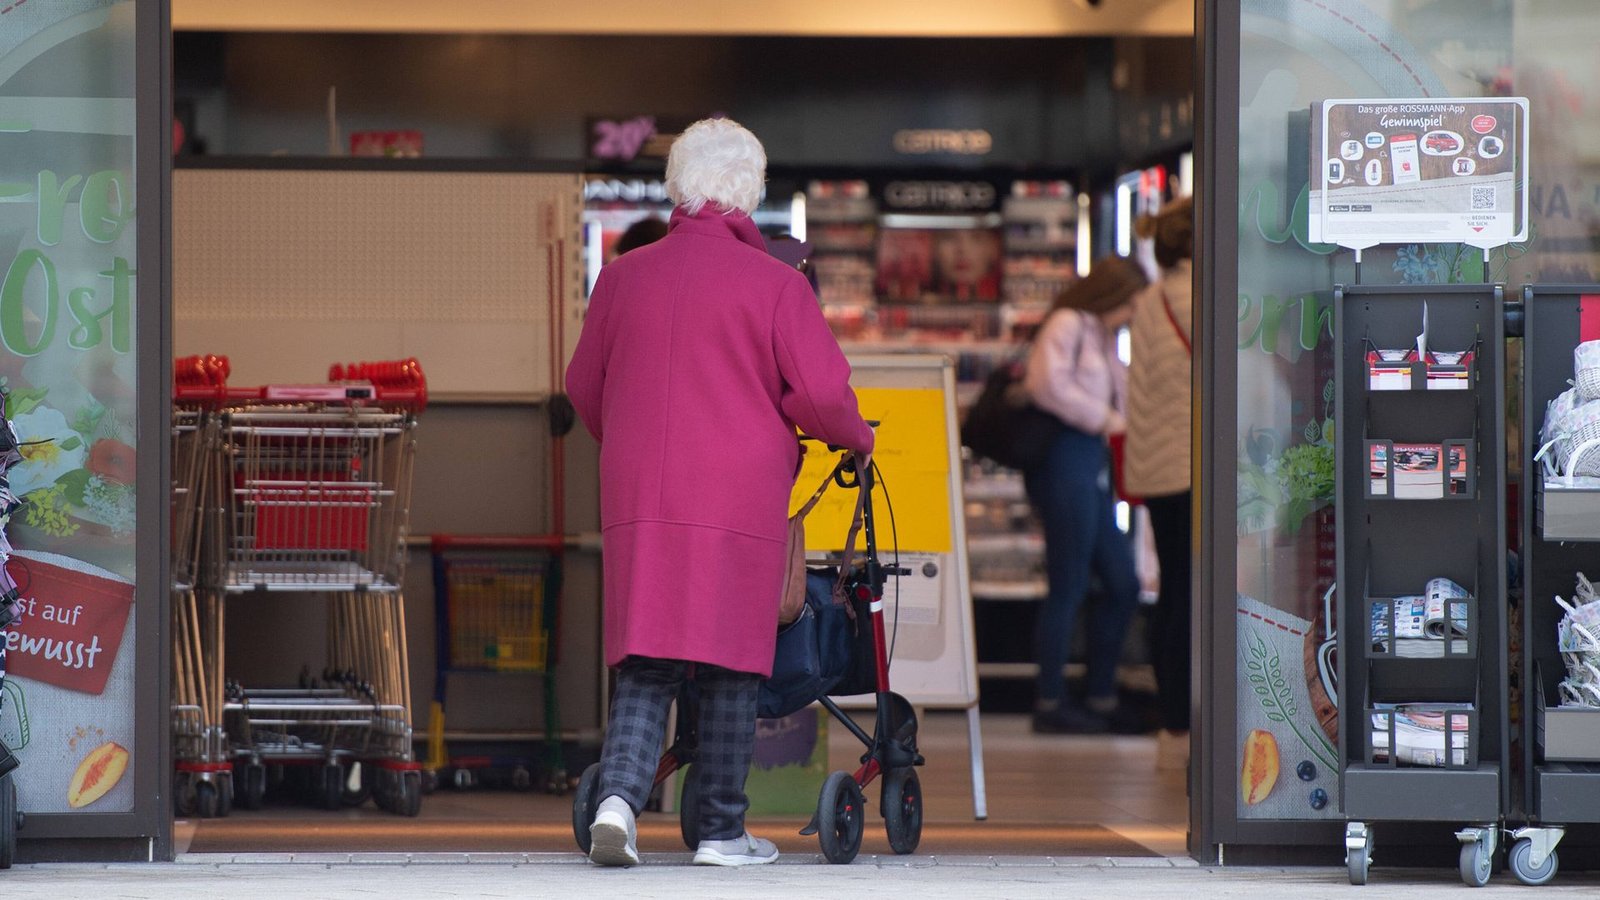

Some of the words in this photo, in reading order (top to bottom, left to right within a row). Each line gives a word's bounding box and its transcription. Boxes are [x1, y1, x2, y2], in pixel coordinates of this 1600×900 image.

[1358, 105, 1373, 114] Das
[1375, 105, 1398, 115] große
[1400, 104, 1466, 114] ROSSMANN-App
[16, 597, 37, 617] st
[42, 604, 83, 625] auf
[5, 630, 102, 669] ewusst
